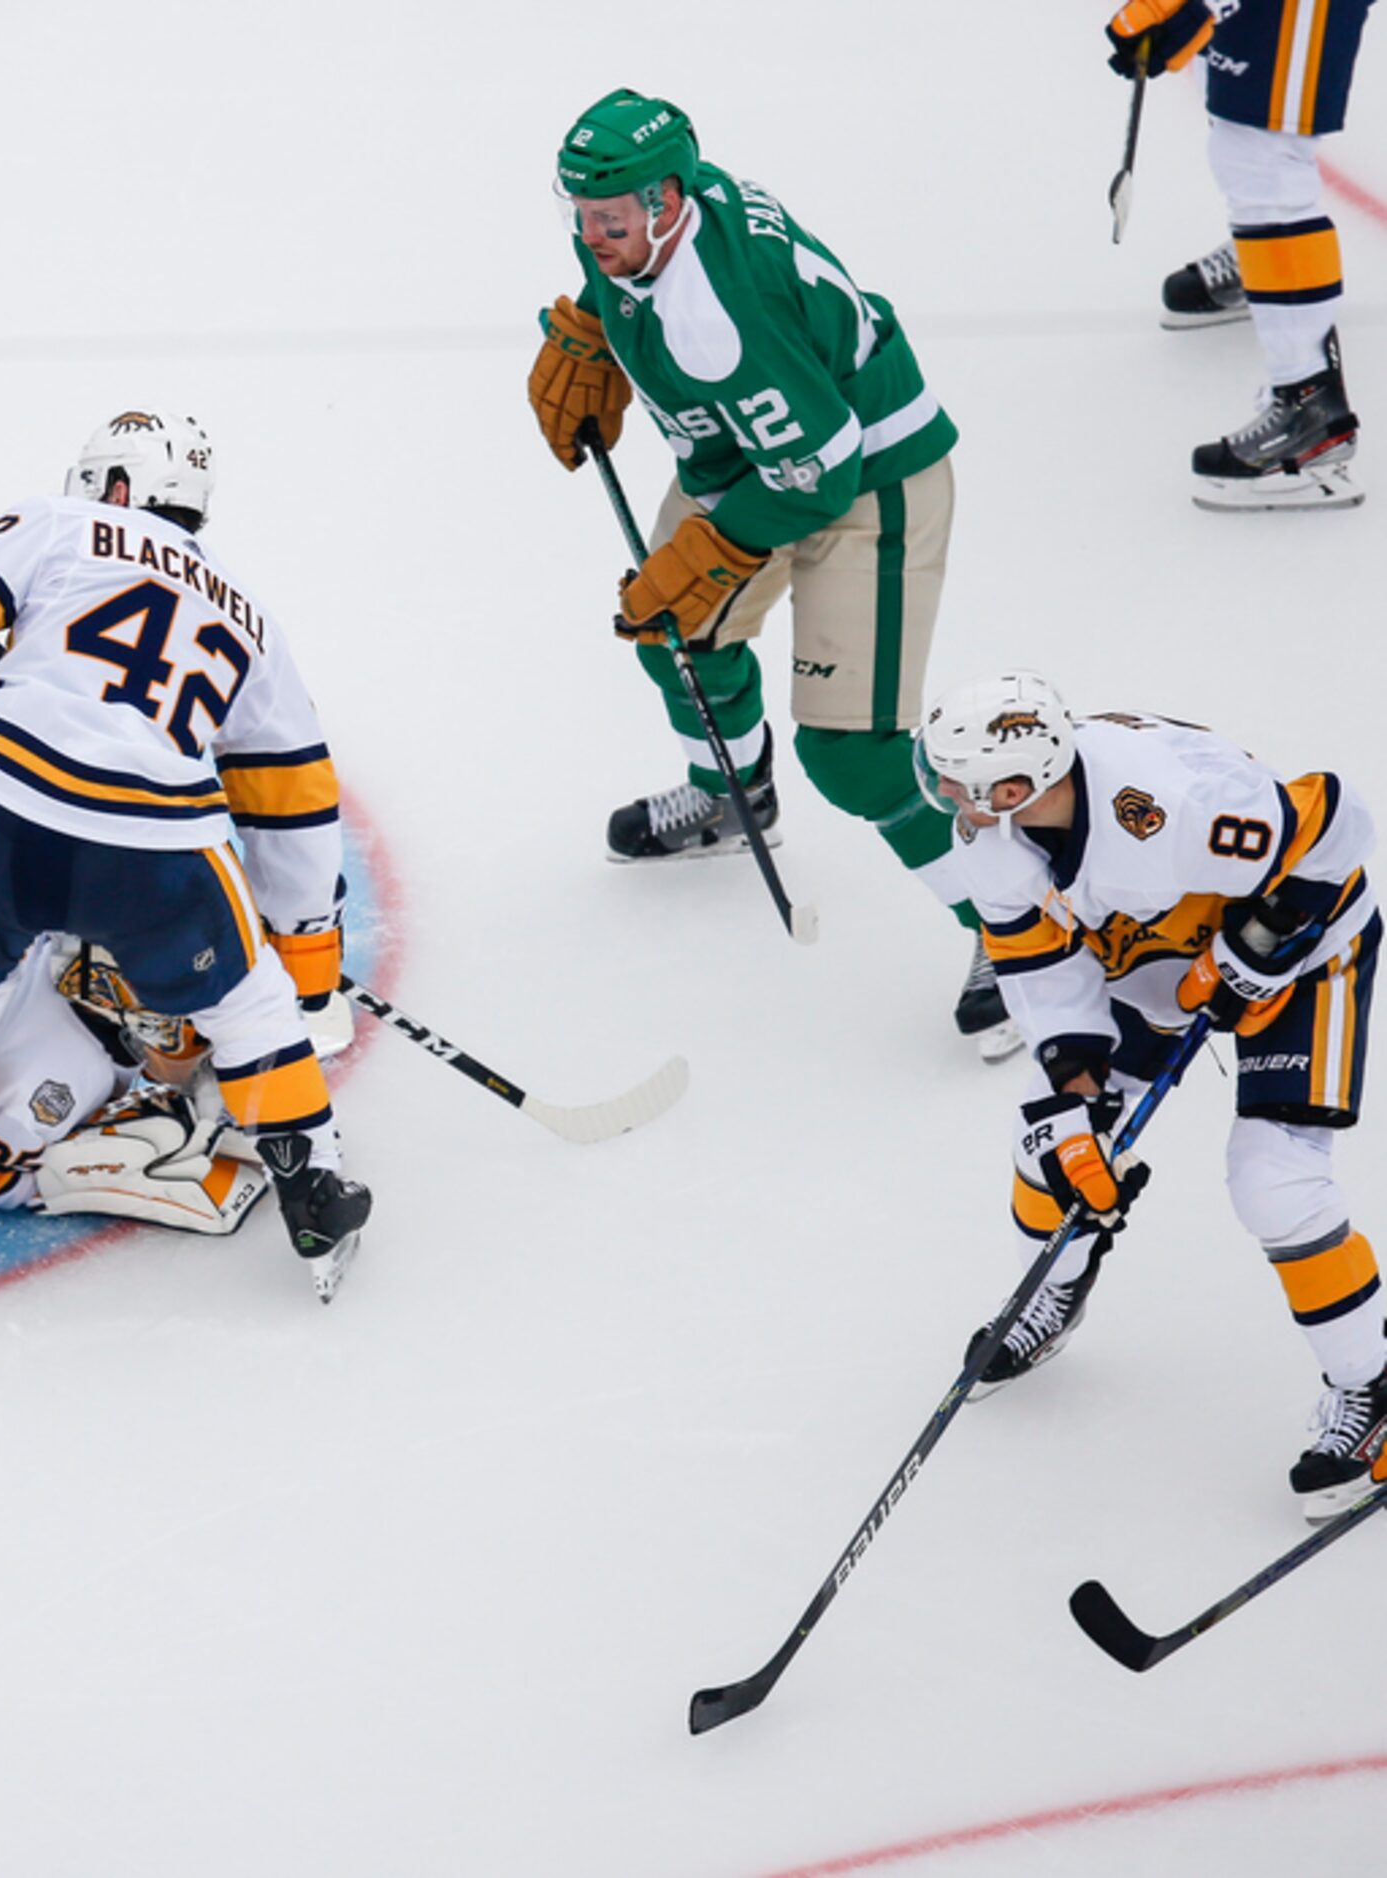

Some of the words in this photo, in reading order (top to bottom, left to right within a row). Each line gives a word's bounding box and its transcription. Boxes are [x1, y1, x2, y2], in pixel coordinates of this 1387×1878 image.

[1206, 45, 1249, 76] CM
[186, 448, 208, 470] 42
[92, 519, 267, 656] BLACKWELL
[65, 577, 252, 760] 42
[792, 655, 838, 679] CM
[1208, 813, 1274, 862] 8
